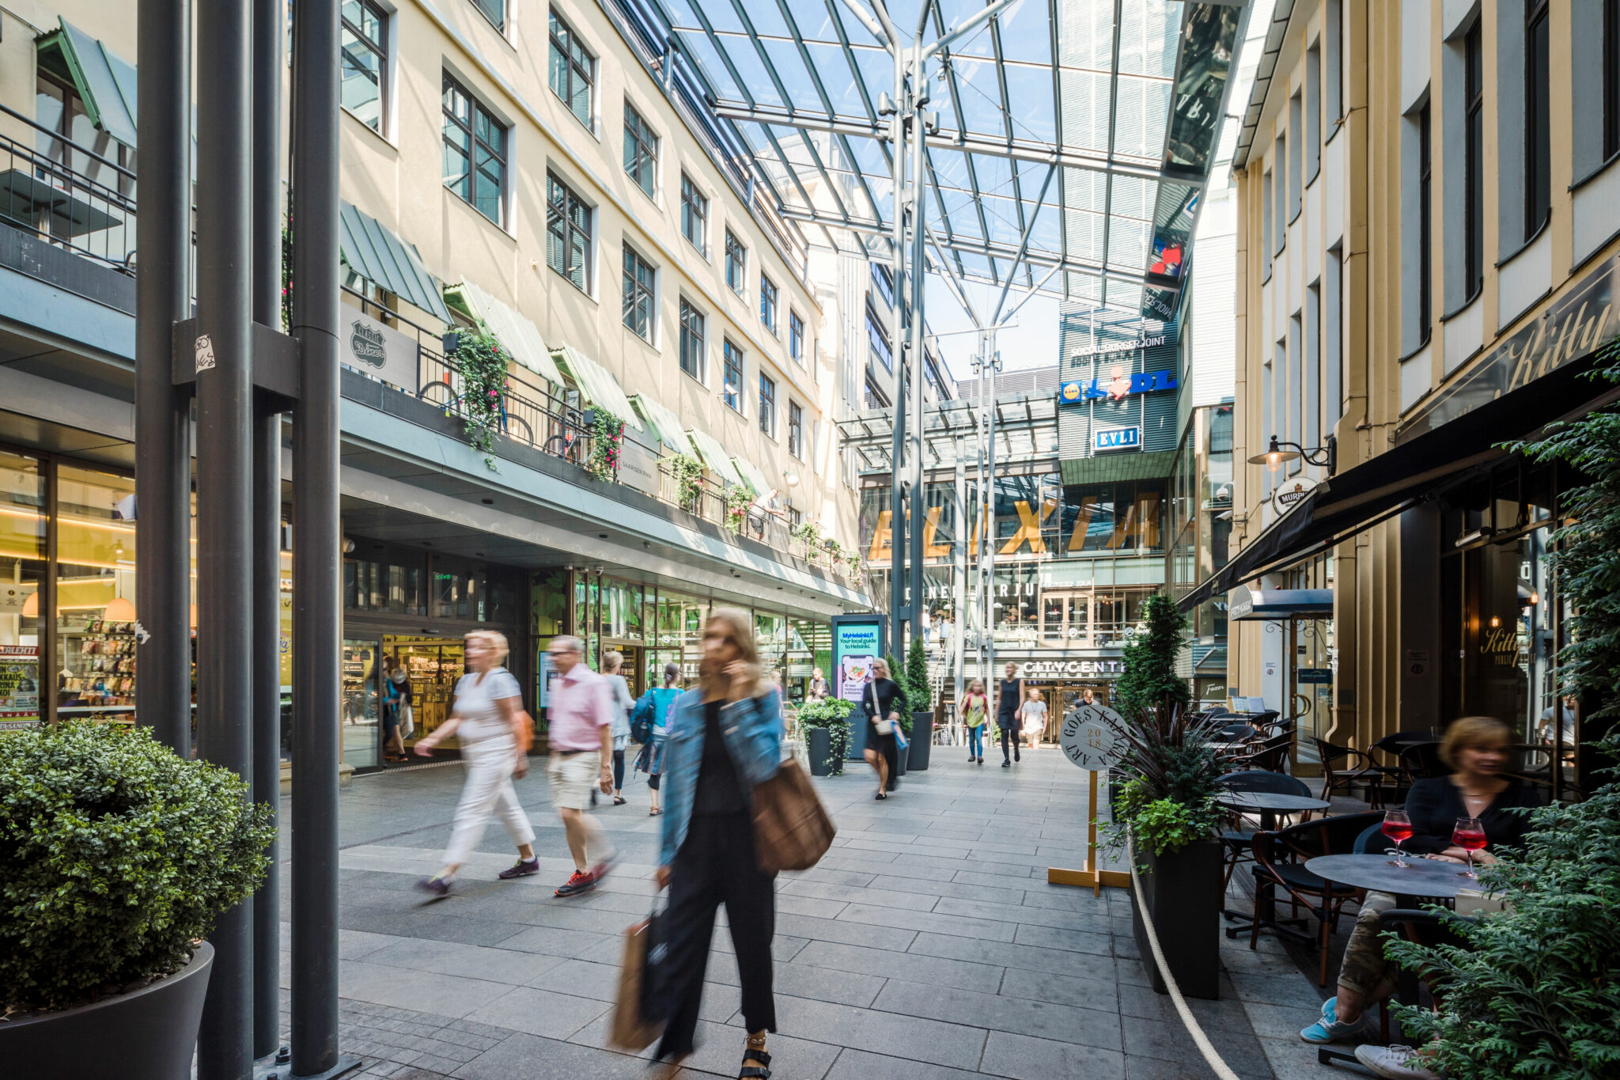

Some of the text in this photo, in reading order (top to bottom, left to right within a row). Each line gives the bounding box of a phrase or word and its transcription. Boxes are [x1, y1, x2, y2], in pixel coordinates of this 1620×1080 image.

[1100, 430, 1134, 446] EVLI
[1281, 492, 1306, 503] MURP
[867, 492, 1161, 560] ELIXIA
[1205, 683, 1224, 695] Fazer
[1064, 709, 1092, 738] GOES
[1087, 728, 1102, 738] 20
